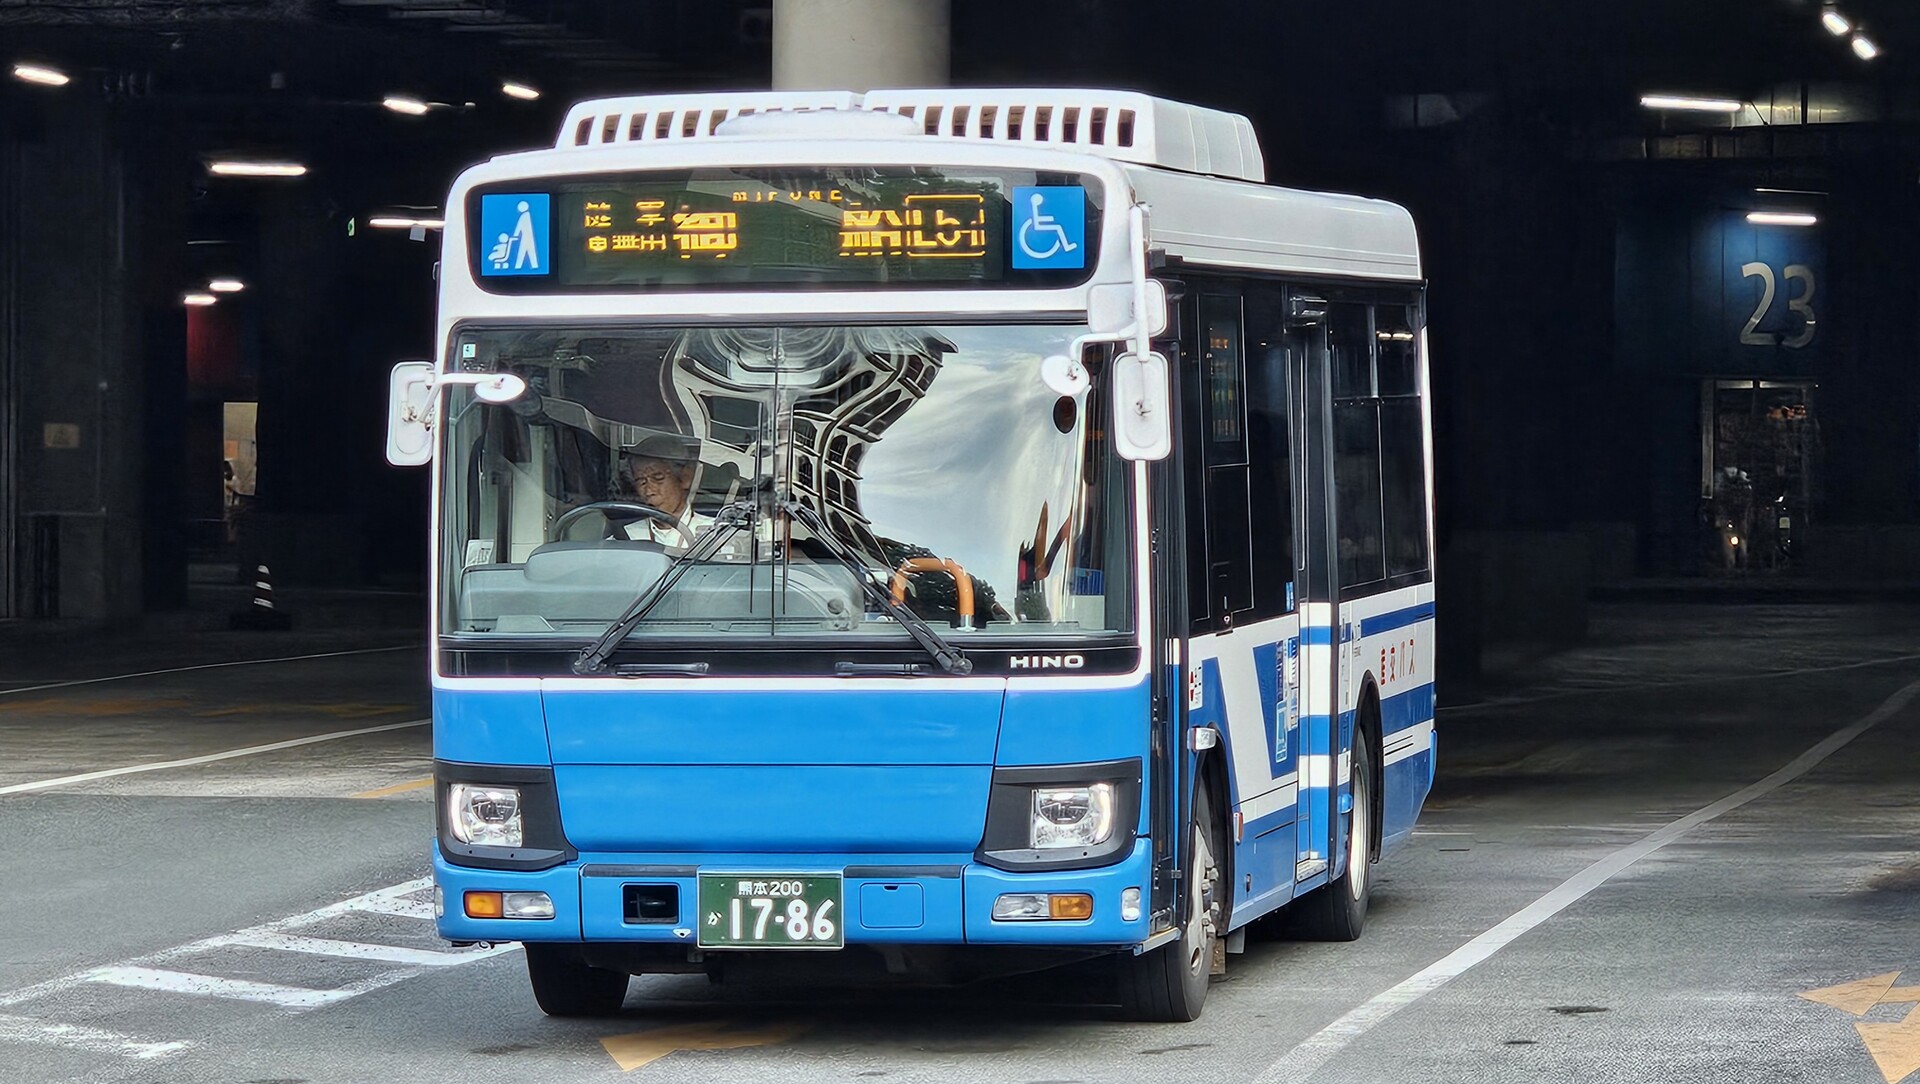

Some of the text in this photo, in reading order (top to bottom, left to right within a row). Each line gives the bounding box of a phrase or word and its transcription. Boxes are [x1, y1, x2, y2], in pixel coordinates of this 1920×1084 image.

[1740, 261, 1816, 348] 23
[1010, 654, 1084, 669] HINO
[732, 898, 835, 941] 17-86
